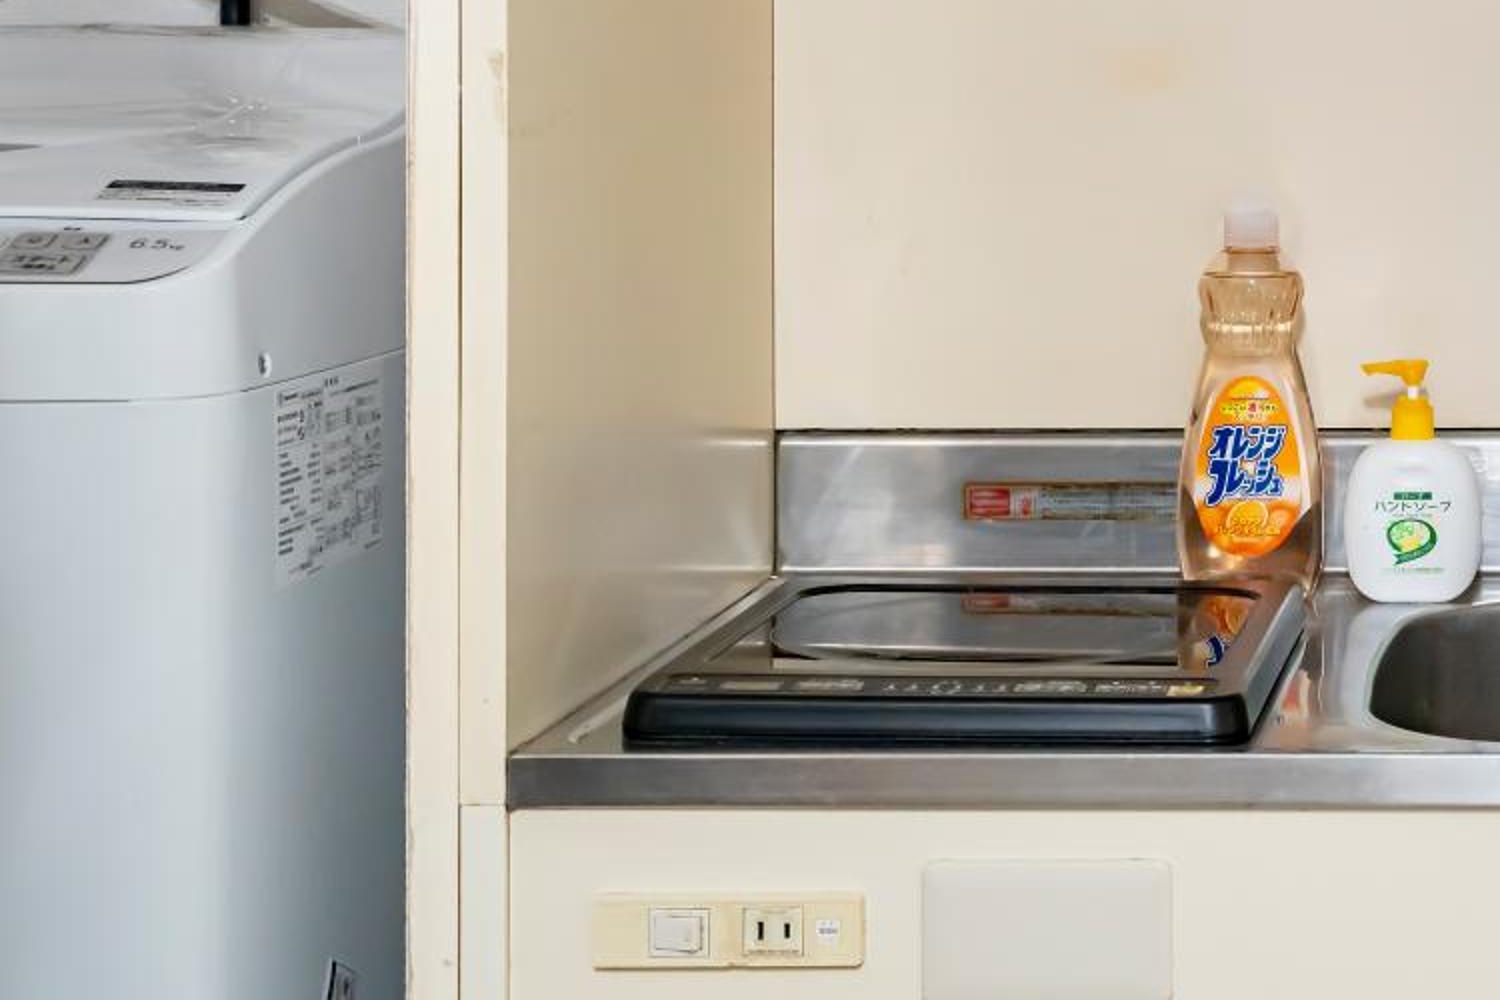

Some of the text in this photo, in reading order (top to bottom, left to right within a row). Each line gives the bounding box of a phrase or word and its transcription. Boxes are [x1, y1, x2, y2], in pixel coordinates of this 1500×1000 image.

[1208, 426, 1288, 459] オレンジ
[1205, 459, 1285, 506] フレッシュ
